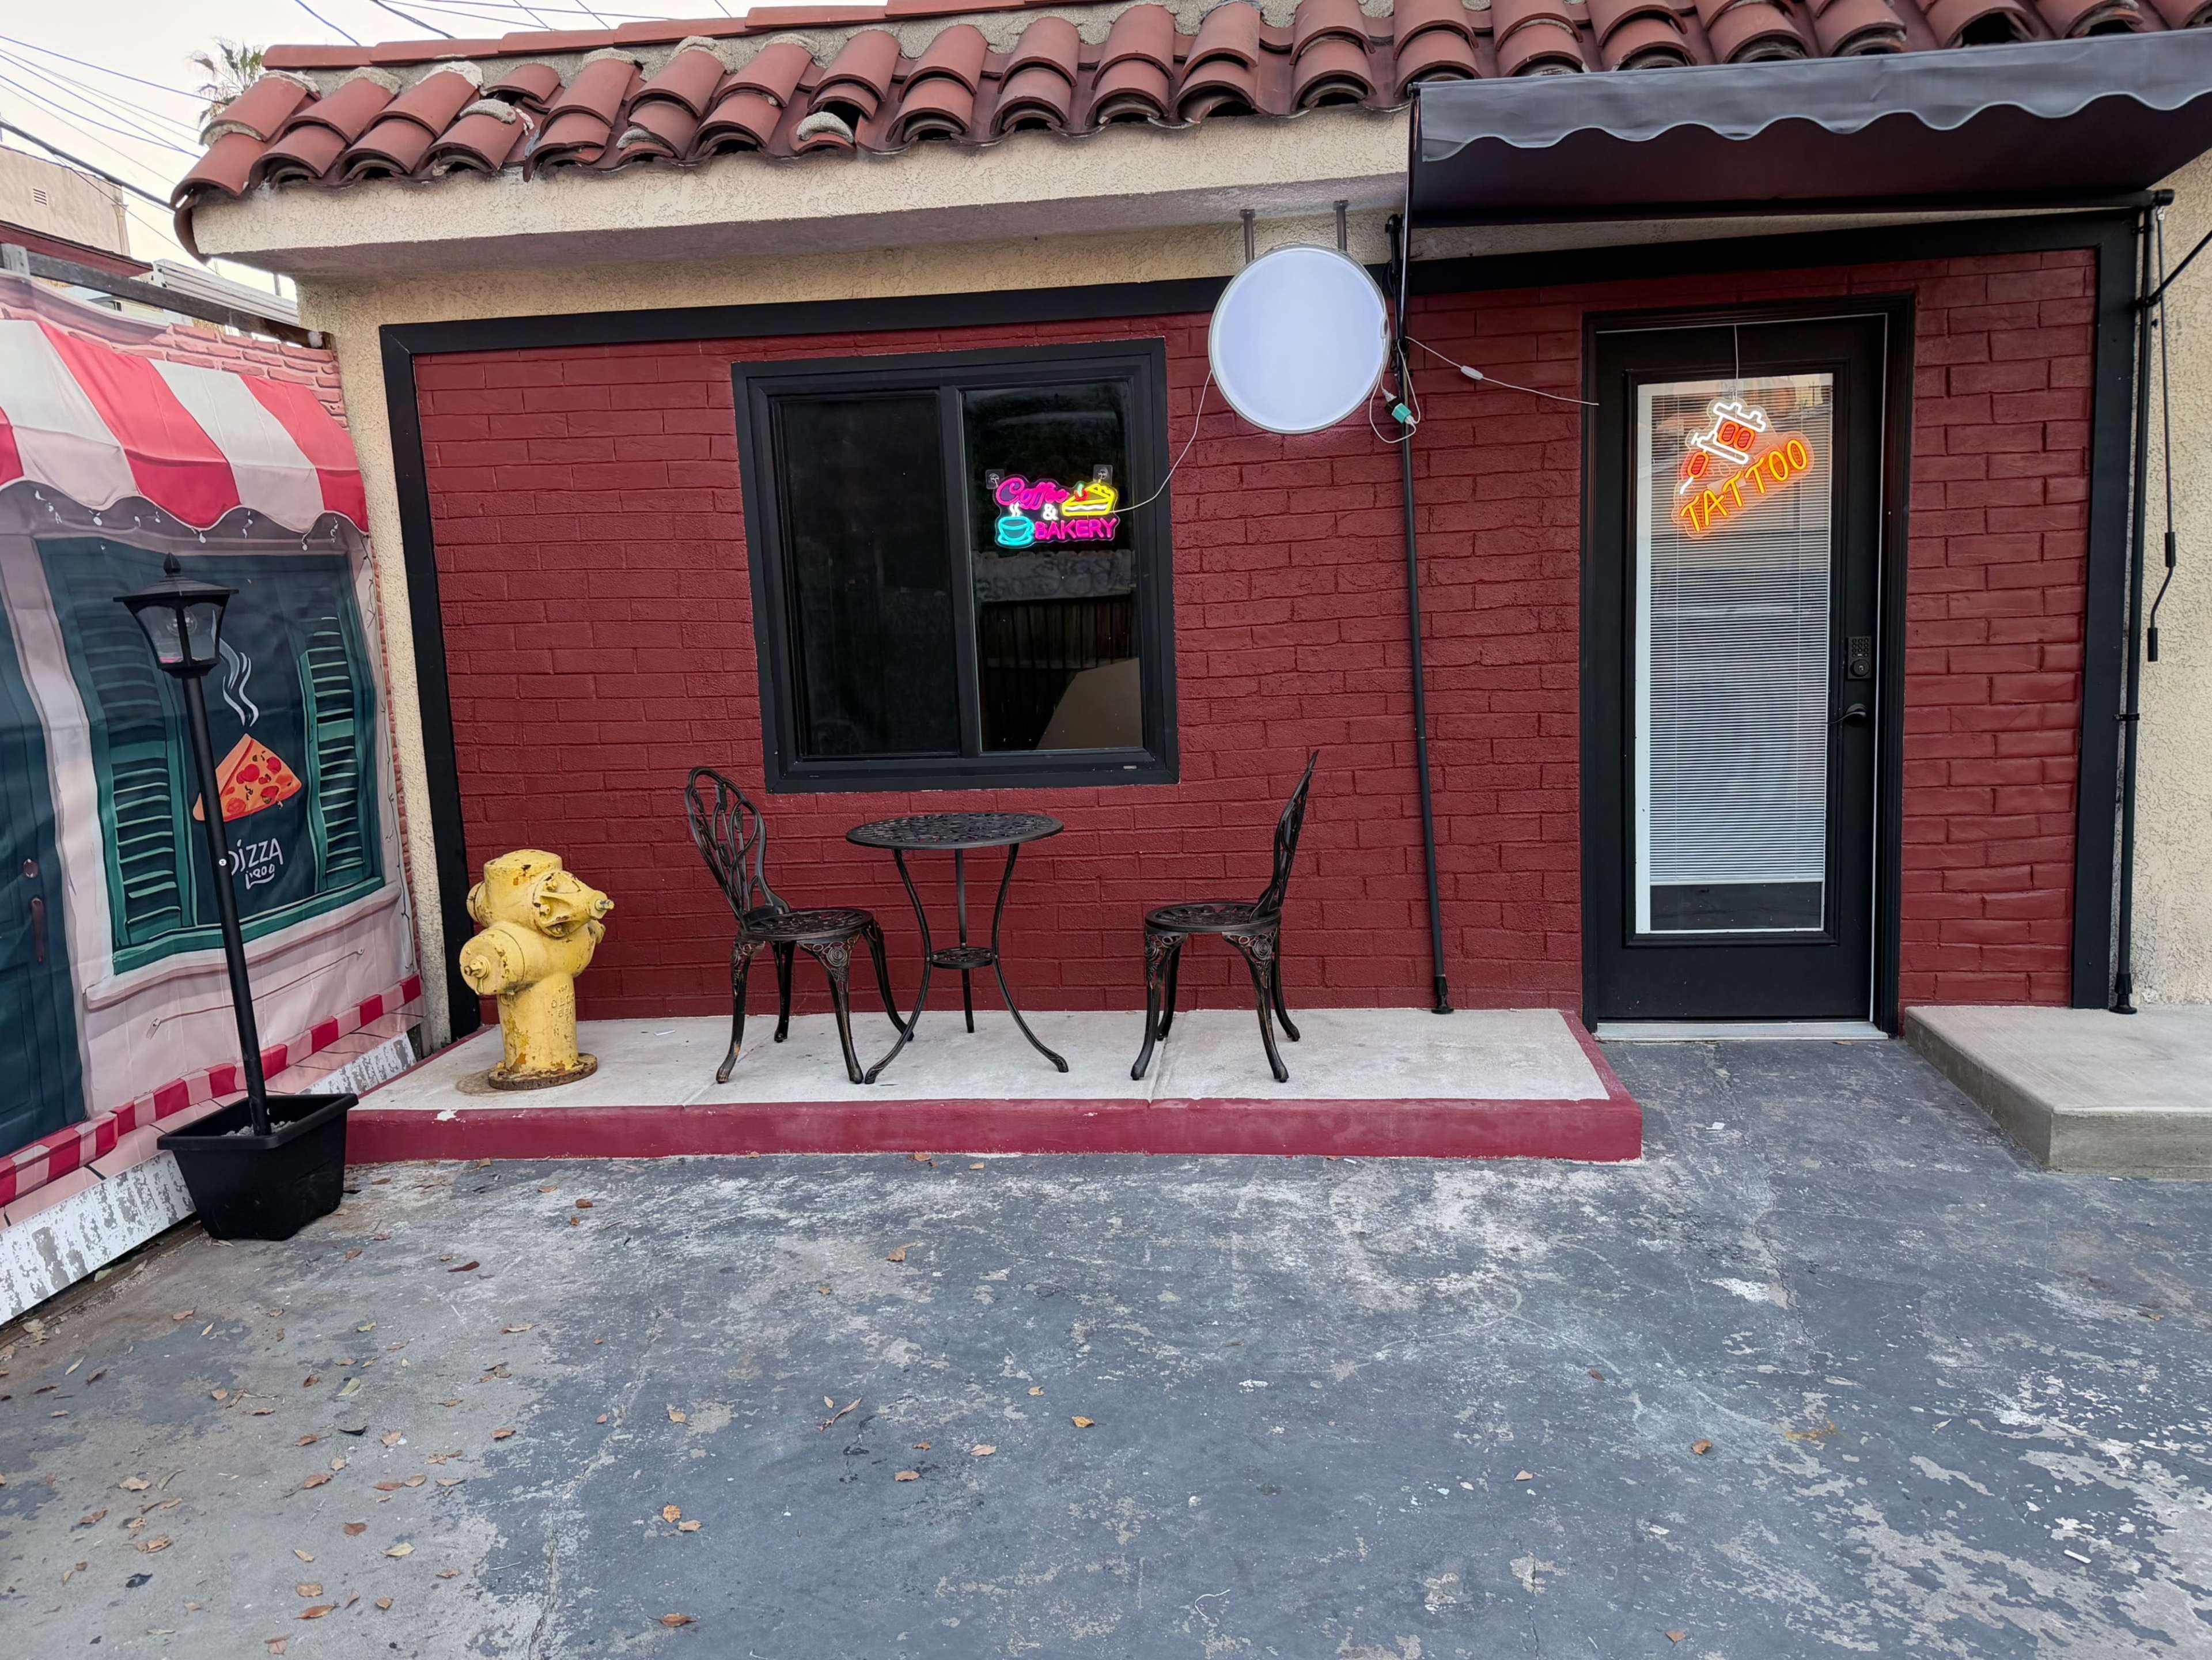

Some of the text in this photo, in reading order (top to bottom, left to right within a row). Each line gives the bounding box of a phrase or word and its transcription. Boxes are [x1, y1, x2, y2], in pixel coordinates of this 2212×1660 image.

[995, 477, 1070, 510] Coffee
[1680, 439, 1808, 532] TATTOO
[1043, 503, 1058, 520] &
[1035, 517, 1117, 539] BAKERY
